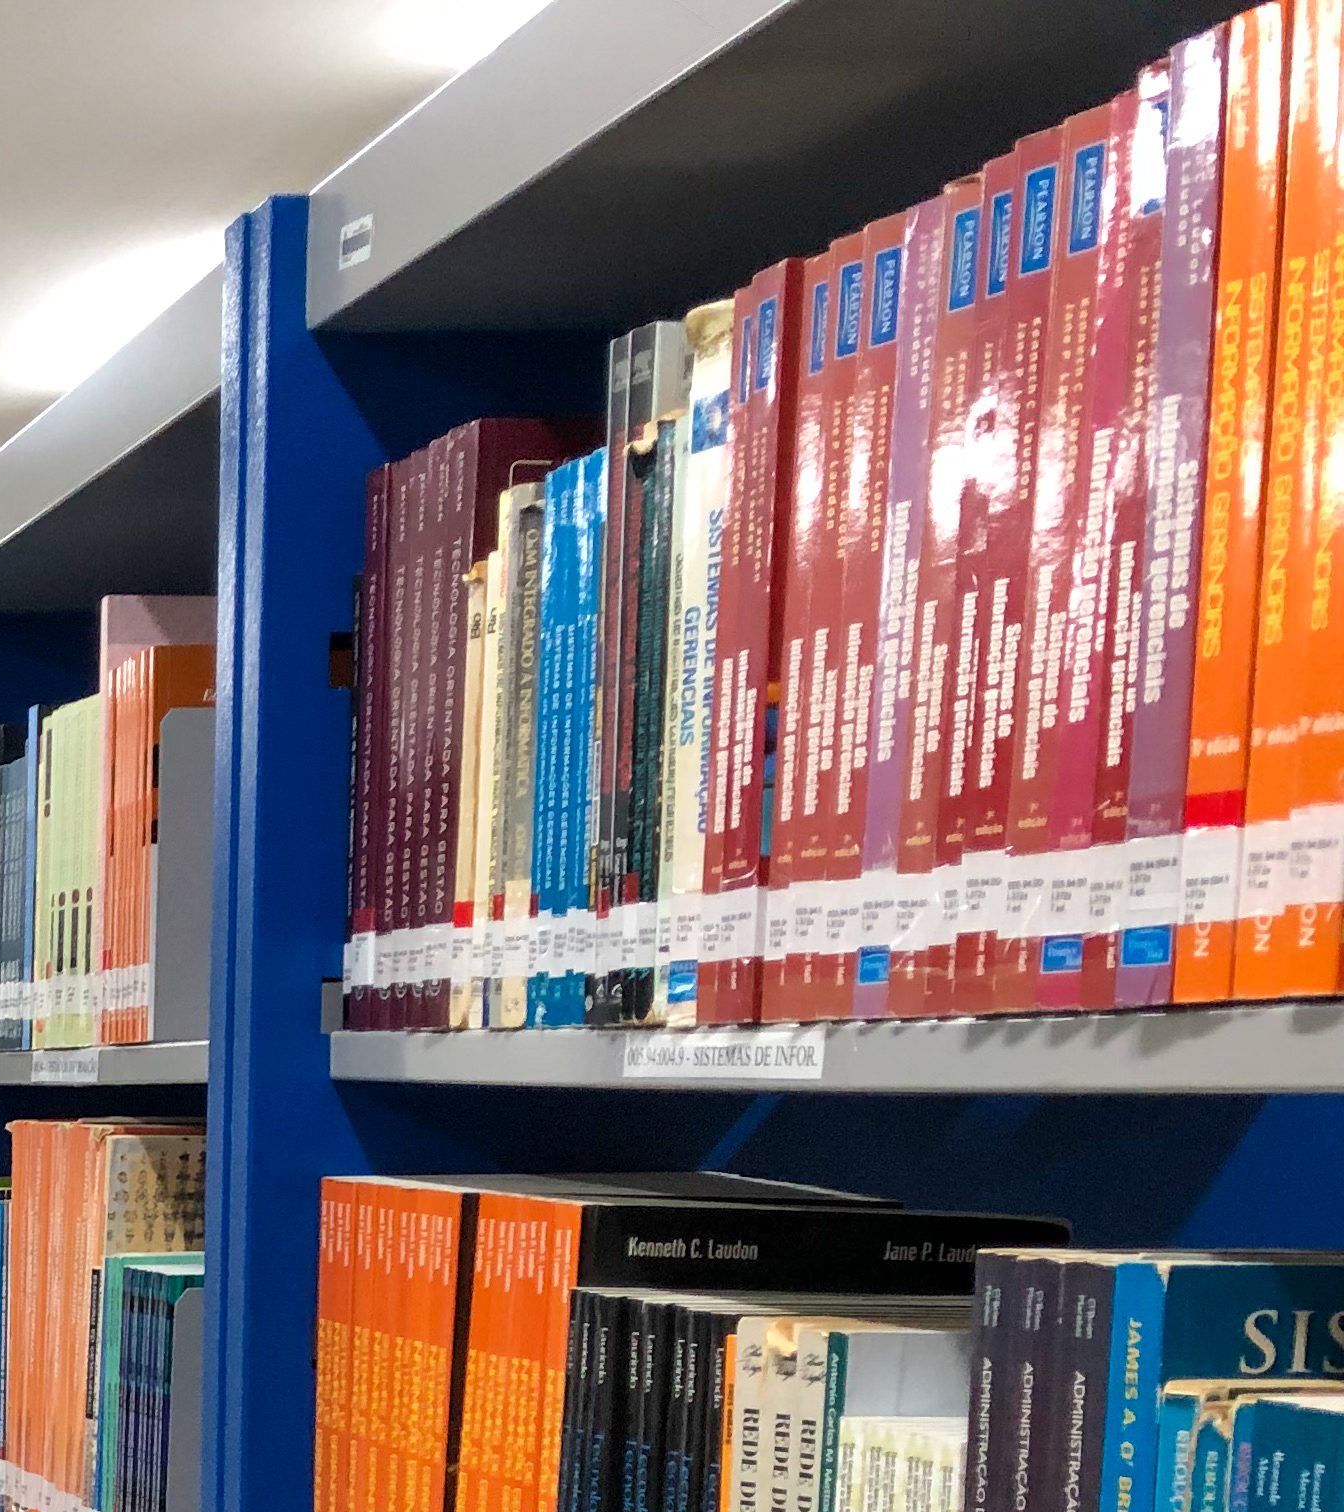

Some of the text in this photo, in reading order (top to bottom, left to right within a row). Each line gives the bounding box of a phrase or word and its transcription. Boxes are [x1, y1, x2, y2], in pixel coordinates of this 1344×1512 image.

[1031, 178, 1049, 260] PEARSON
[1079, 157, 1098, 239] PEARSON
[880, 258, 896, 333] PEARSON
[958, 220, 975, 297] PEARSON
[1020, 422, 1034, 500] Laudon
[1202, 280, 1243, 658] INFORMAÇÃO GERENCIAIS
[1264, 256, 1306, 645] INFORMAÇÃO GERENCIAIS
[871, 481, 884, 552] Laudon
[447, 537, 461, 658] TECNOLOGIA
[704, 509, 724, 631] SISTEMAS
[520, 569, 537, 667] INTEGRADO
[703, 638, 720, 669] DE
[679, 606, 701, 745] GERENCIAIS
[441, 666, 455, 774] ORIENTADA
[438, 783, 448, 833] PARA
[693, 1046, 751, 1067] SISTEMAS
[755, 1046, 771, 1067] DE
[628, 1236, 758, 1260] Kenneth C. Laudon
[884, 1239, 976, 1263] Jane P. Laud
[1121, 1318, 1143, 1400] JAMES
[740, 1408, 760, 1474] REDE
[773, 1413, 791, 1477] REDE
[797, 1419, 817, 1487] REDE
[824, 1408, 837, 1446] Carlos
[1011, 1363, 1035, 1511] ADMINISTRAÇÃO
[738, 1481, 757, 1512] DE
